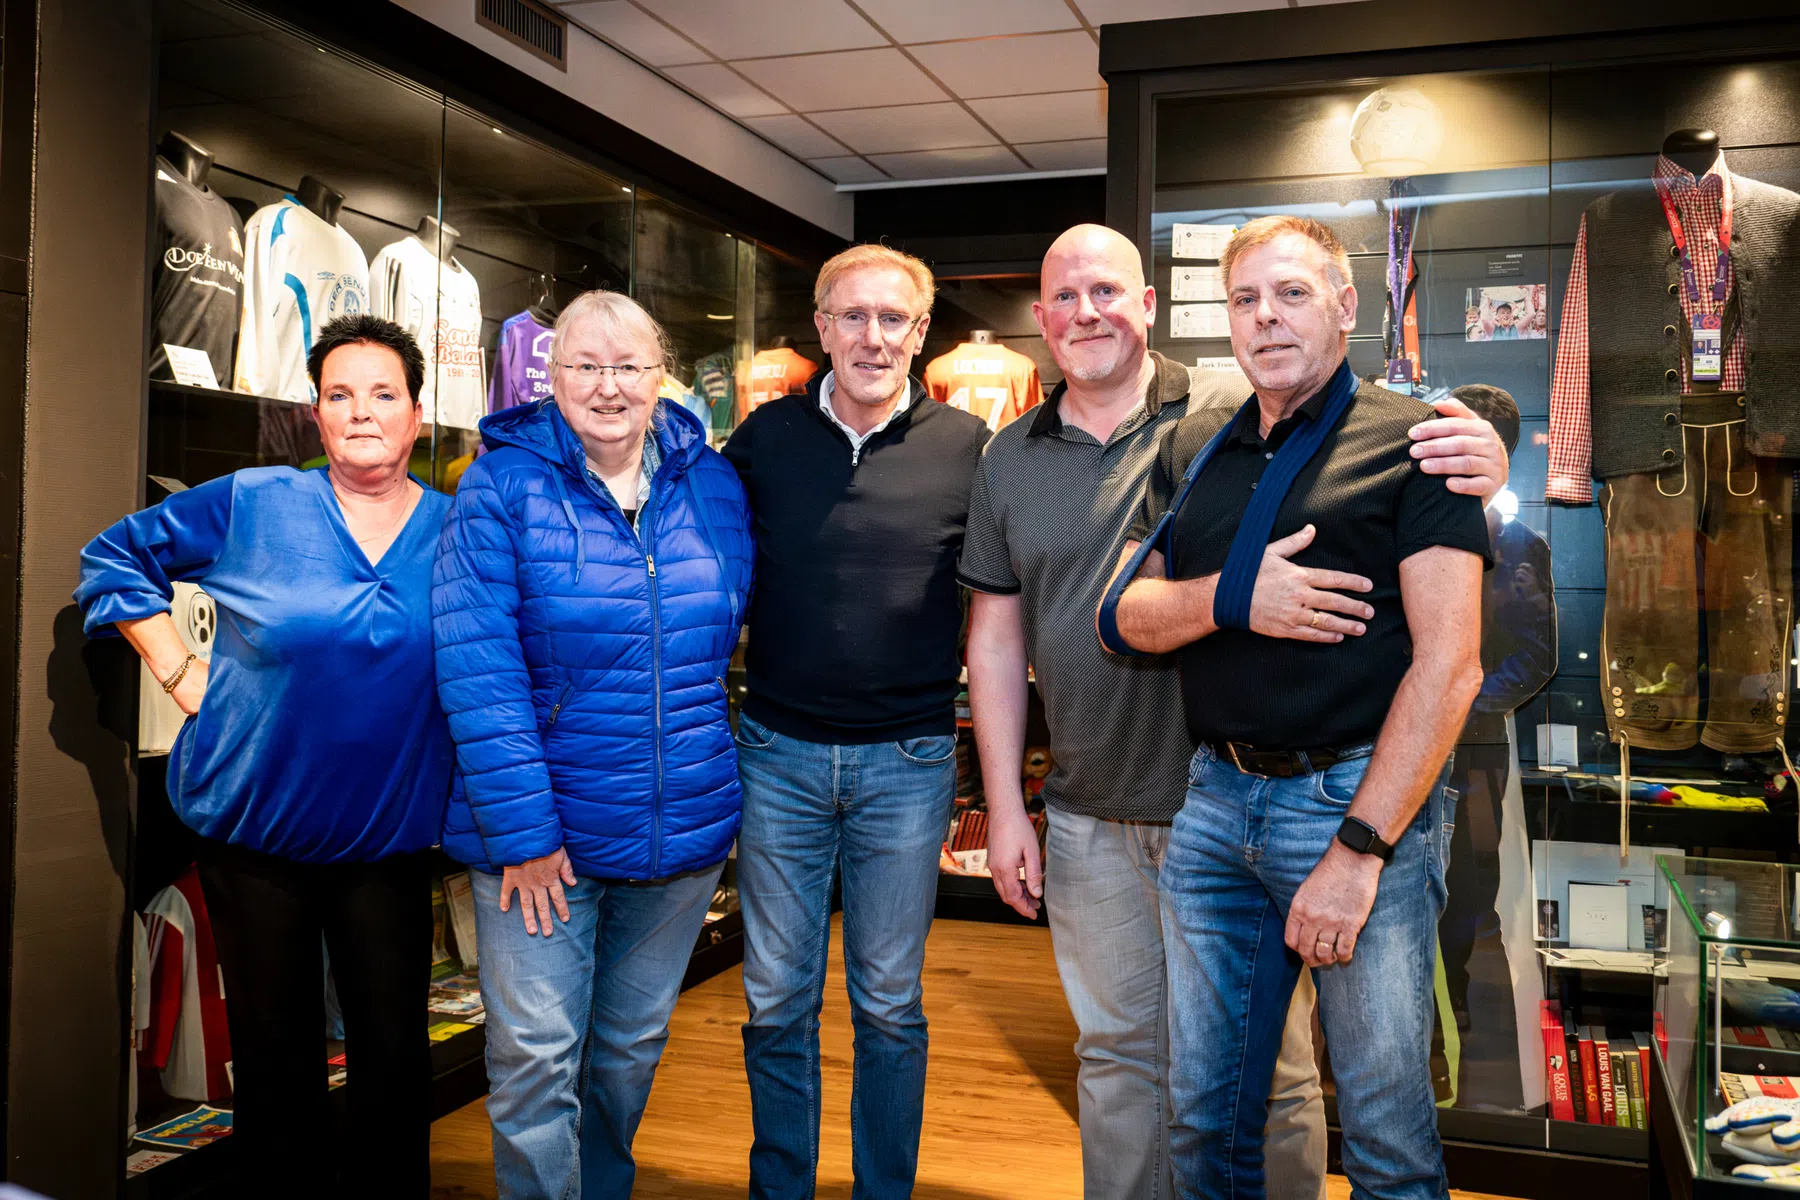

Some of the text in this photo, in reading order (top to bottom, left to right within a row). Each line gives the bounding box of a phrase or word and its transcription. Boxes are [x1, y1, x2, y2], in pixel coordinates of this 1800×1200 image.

[525, 367, 547, 379] The
[1559, 1073, 1568, 1101] LOUIS
[1598, 1047, 1613, 1113] LOUIS VAN GAAL
[1614, 1085, 1629, 1116] LOUIS
